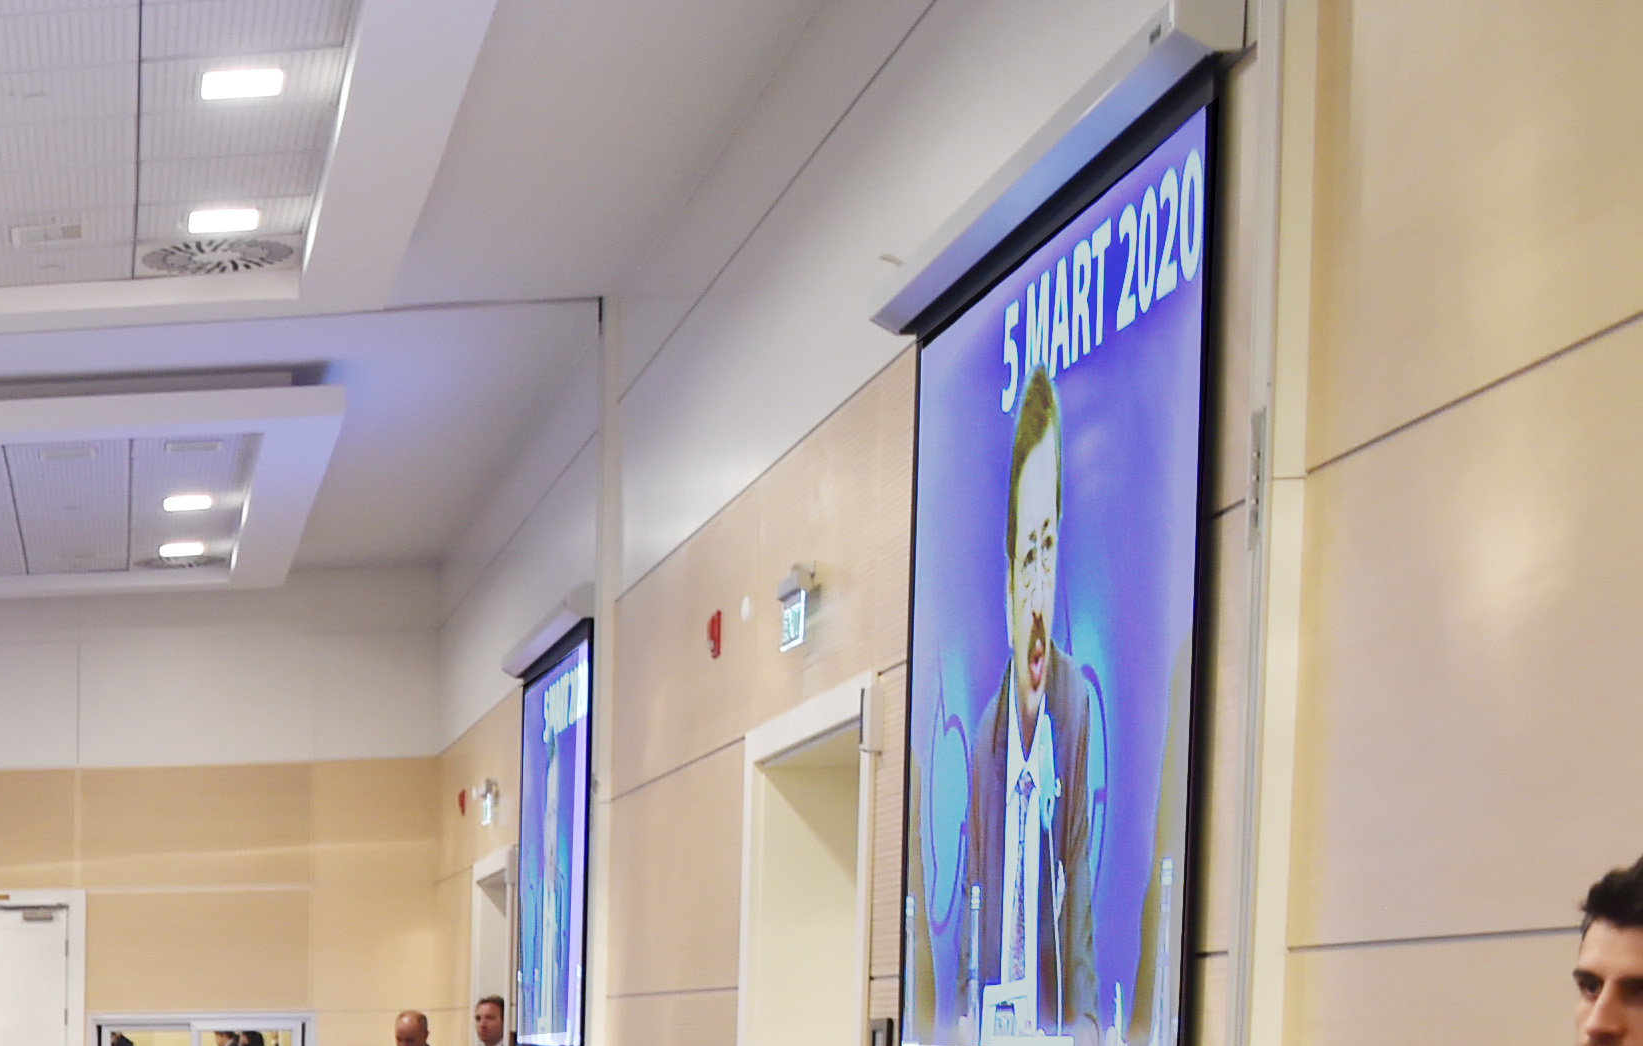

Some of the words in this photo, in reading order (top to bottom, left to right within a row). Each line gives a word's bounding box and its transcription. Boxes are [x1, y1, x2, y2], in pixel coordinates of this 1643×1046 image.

[1000, 301, 1020, 413] 5
[1025, 217, 1112, 380] MART
[1116, 148, 1206, 332] 2020
